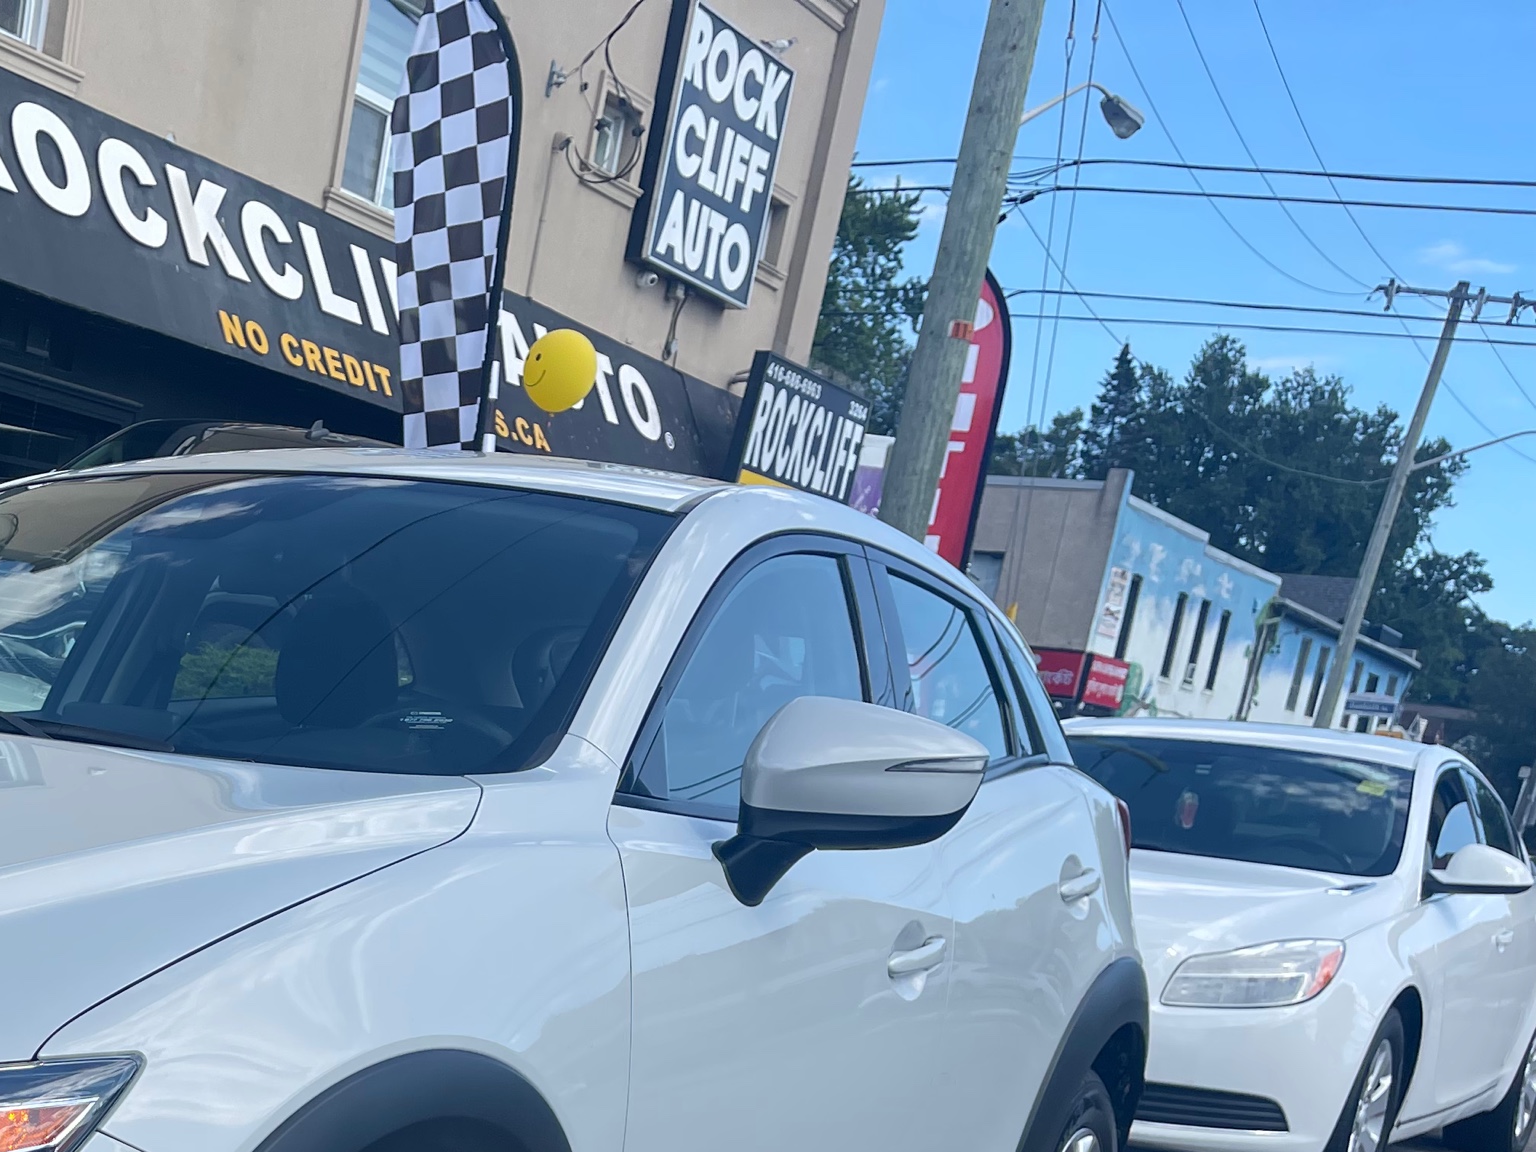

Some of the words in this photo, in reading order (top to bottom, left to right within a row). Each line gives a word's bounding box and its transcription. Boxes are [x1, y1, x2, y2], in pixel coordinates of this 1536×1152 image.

[683, 8, 790, 141] ROCK
[674, 103, 772, 213] CLIFF
[656, 189, 751, 292] AUTO
[218, 309, 270, 355] NO
[279, 332, 394, 397] CREDIT
[494, 408, 552, 452] S.CA
[499, 308, 662, 442] ATO
[743, 381, 865, 500] ROCKCLIFF
